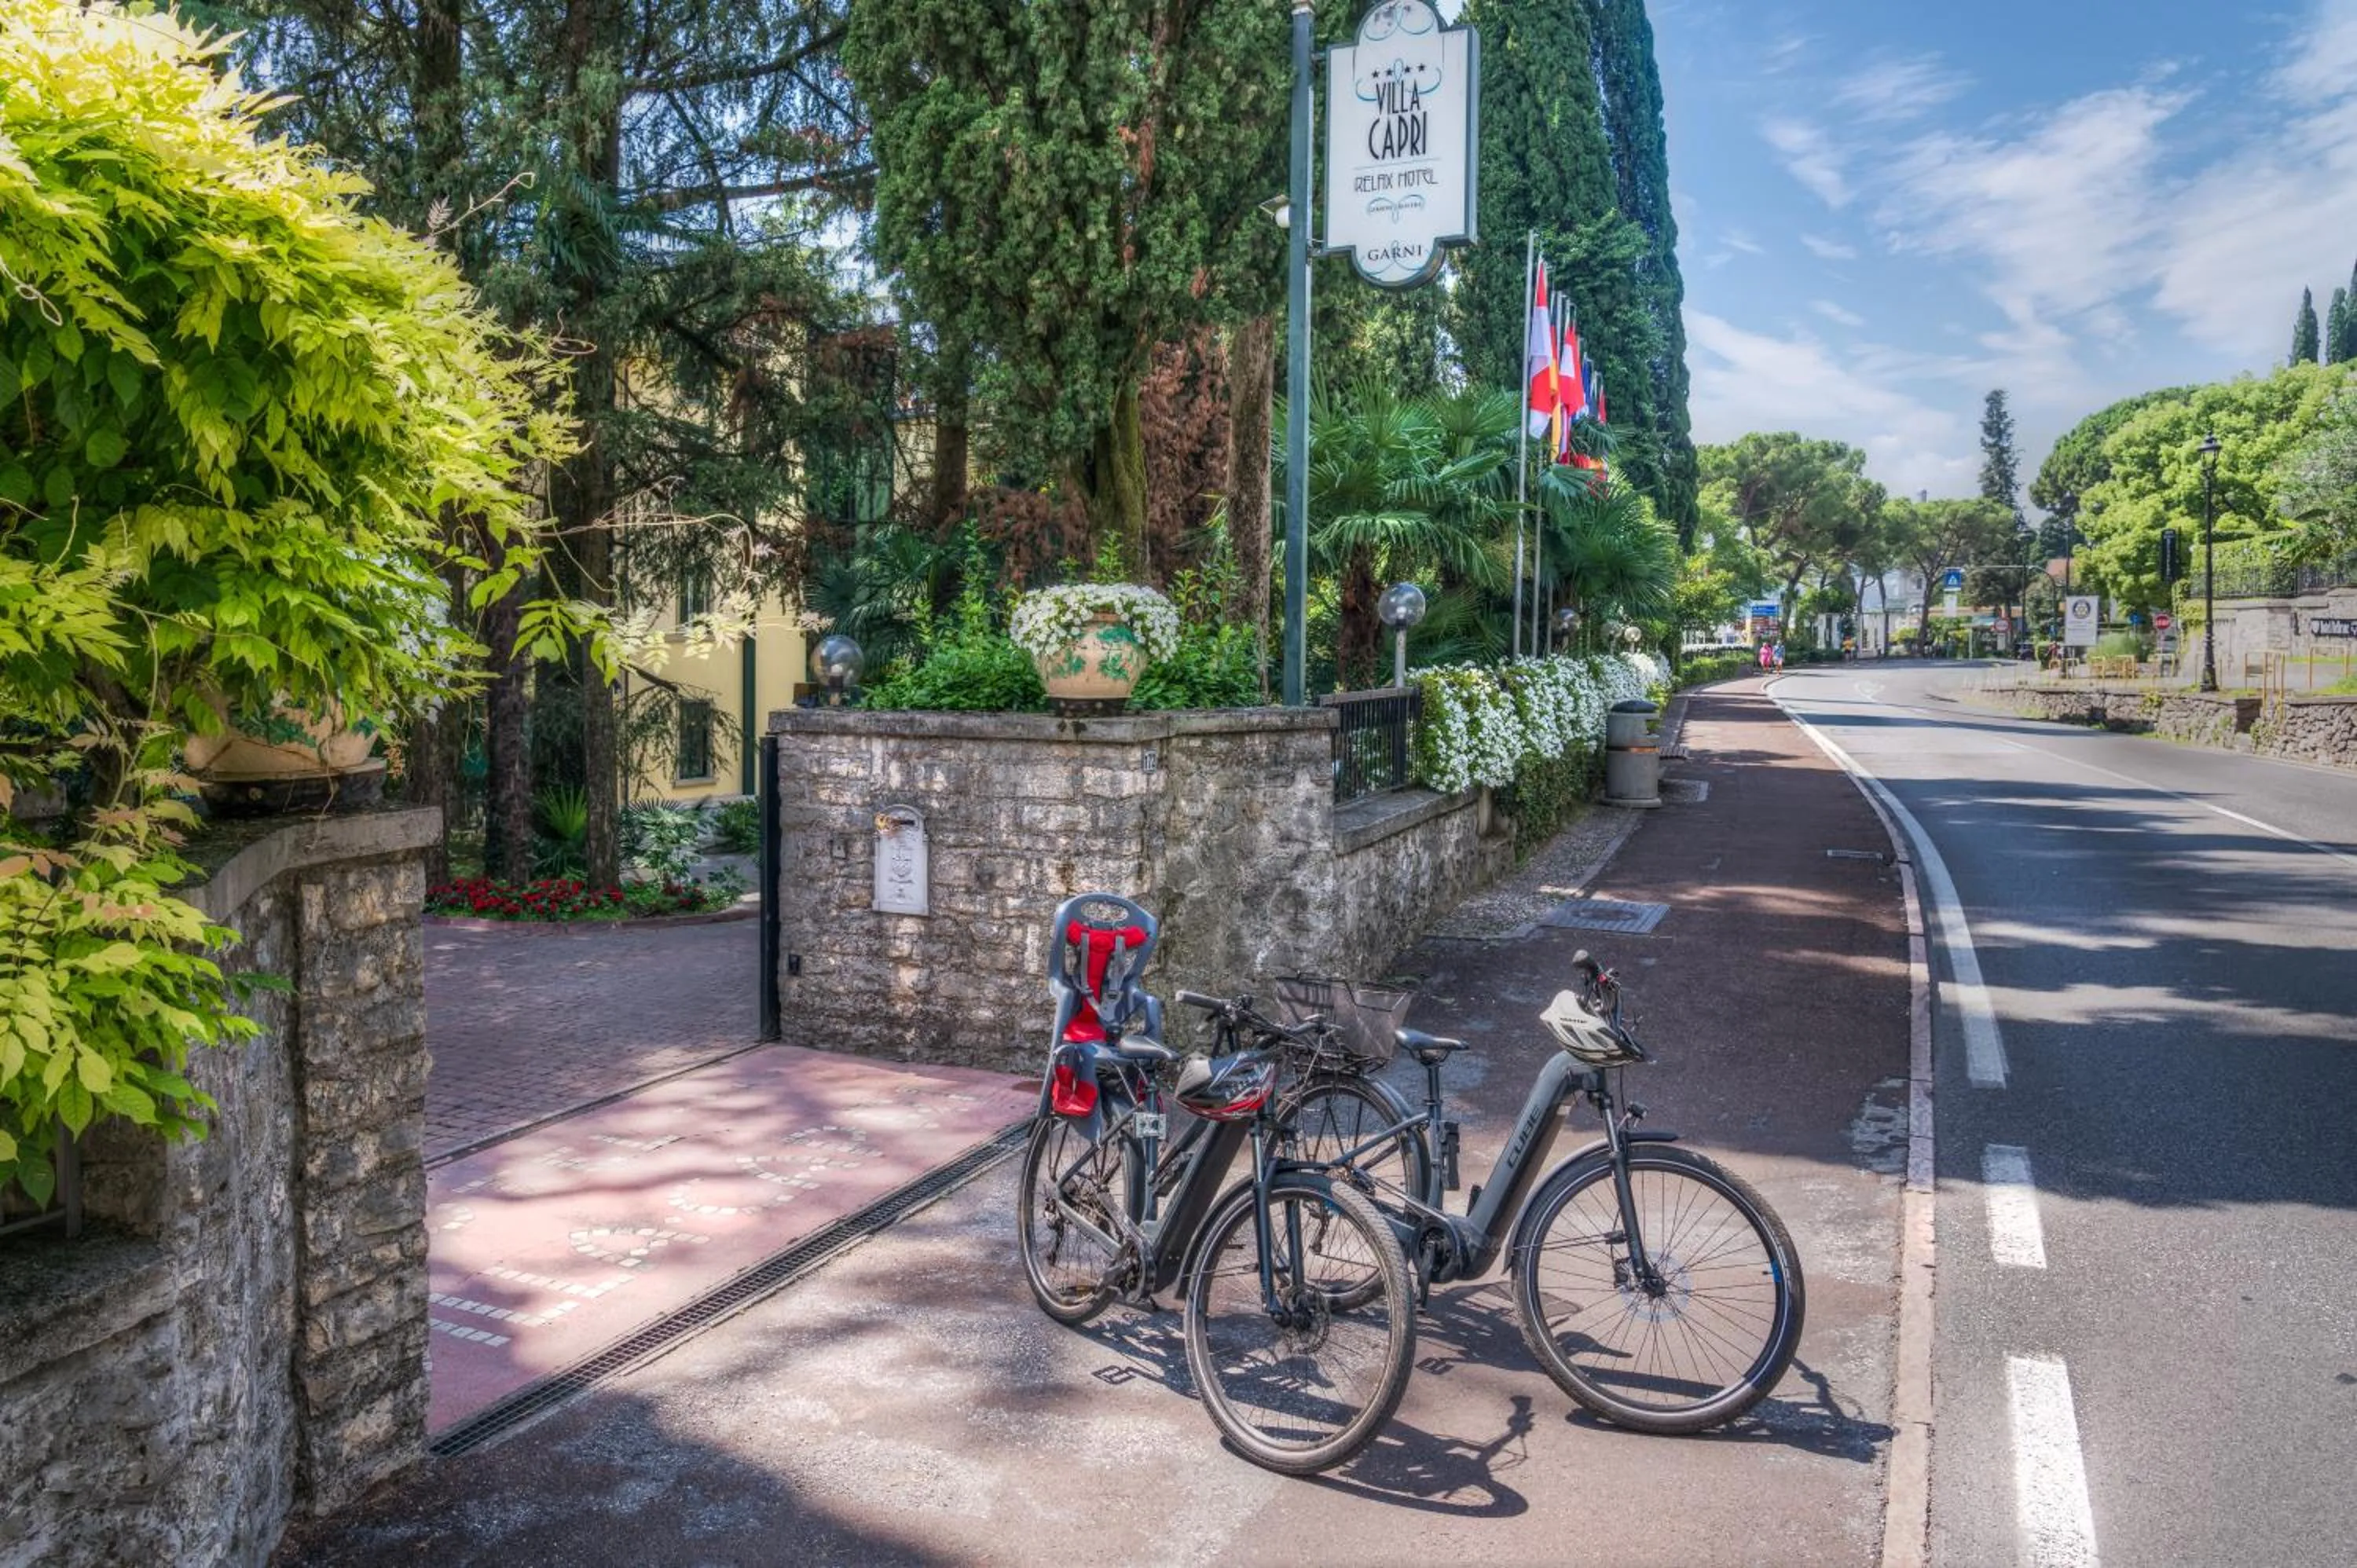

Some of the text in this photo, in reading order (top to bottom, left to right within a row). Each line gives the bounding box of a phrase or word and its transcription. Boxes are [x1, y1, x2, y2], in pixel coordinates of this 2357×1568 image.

[1376, 79, 1420, 115] VILLA
[1369, 111, 1427, 160] CAPRI
[1354, 168, 1439, 192] RELAX HOTEL
[1368, 244, 1421, 261] GARNI
[1506, 1105, 1541, 1169] CUBE
